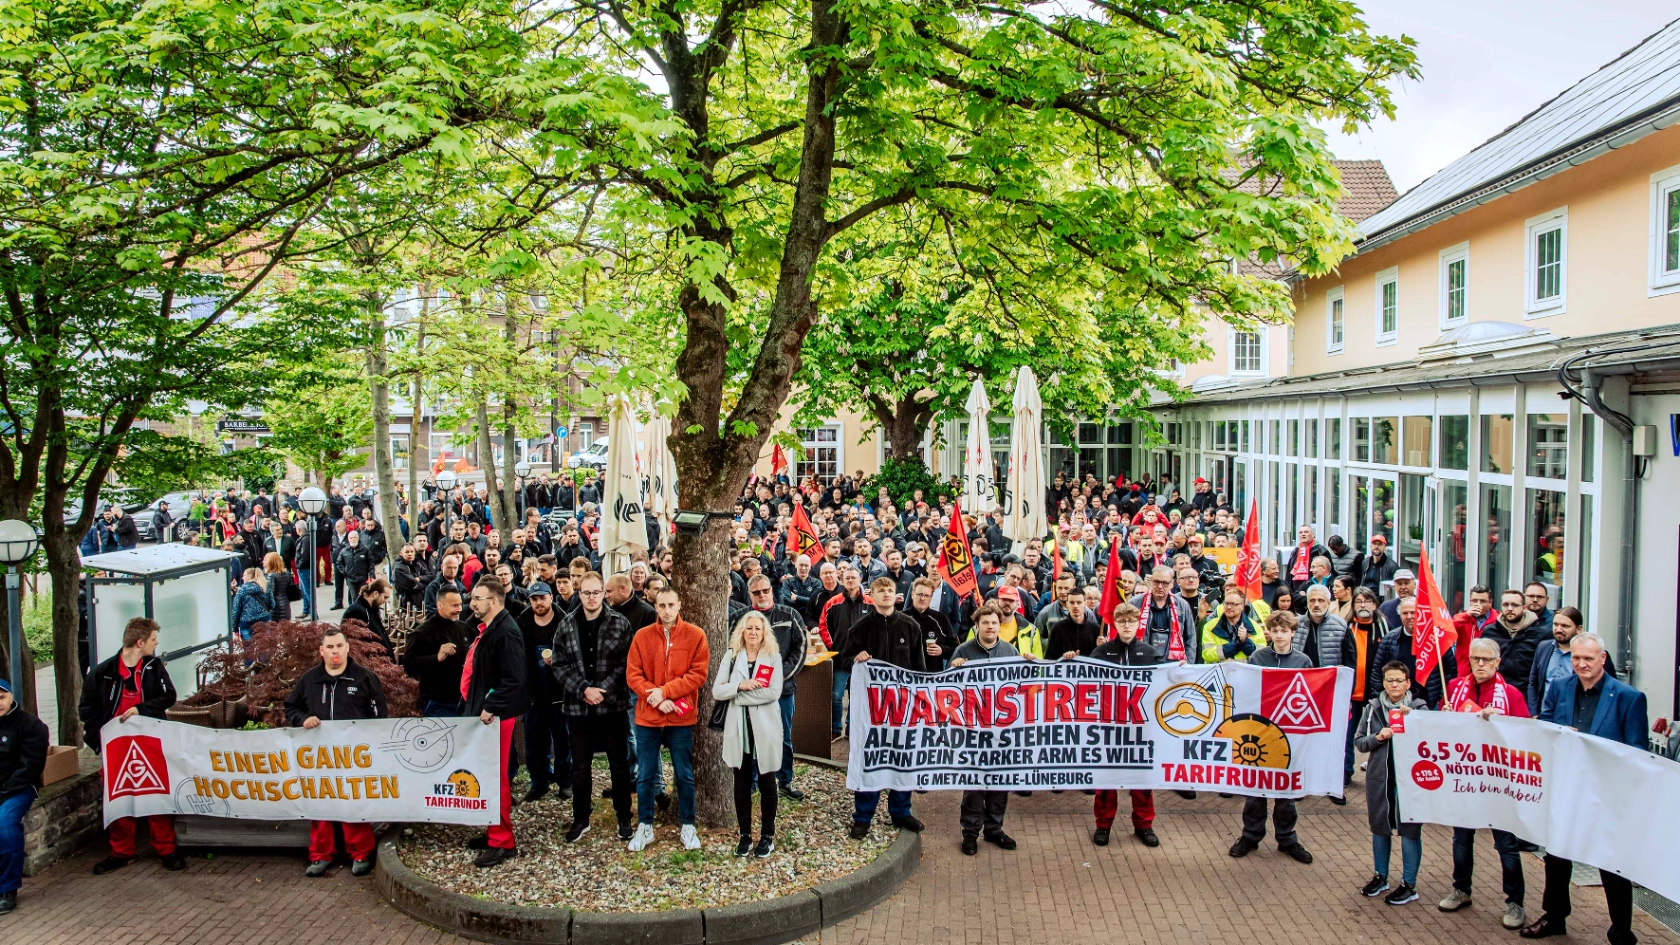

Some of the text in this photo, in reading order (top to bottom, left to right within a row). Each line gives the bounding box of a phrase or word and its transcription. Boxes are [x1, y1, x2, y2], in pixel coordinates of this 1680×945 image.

[966, 664, 1062, 682] AUTOMOBILE
[1065, 664, 1153, 682] HANNOVER
[867, 680, 1150, 728] WARNSTREIK
[864, 722, 1154, 750] ALLE RÄDER STEHEN STILL,
[210, 743, 372, 774] EINEN GANG
[864, 747, 1154, 767] WENN DEIN STARKER ARM ES WILL!
[1184, 739, 1257, 762] KFZ HU
[1417, 740, 1542, 773] 6,5 % MEHR
[917, 769, 1094, 787] IG METALL CELLE-LÜNEBURG
[1161, 763, 1302, 790] TARIFRUNDE
[1446, 762, 1542, 787] NÖTIG UND FAIR!
[193, 774, 400, 801] HOCHSCHALTEN
[434, 783, 454, 796] KFZ
[1453, 778, 1543, 804] Ich bin dabei!
[424, 796, 487, 810] TARIFRUNDE
